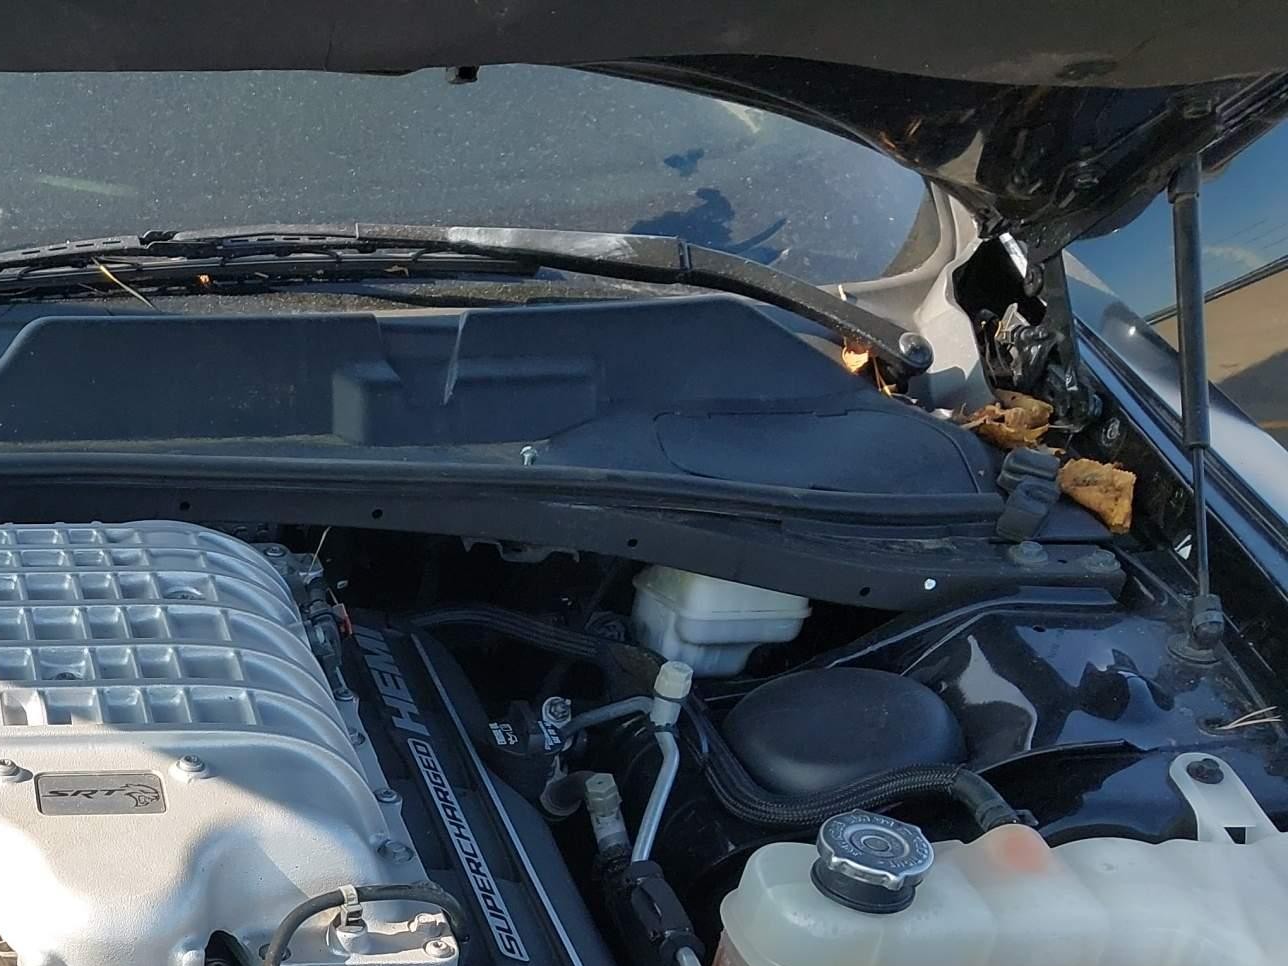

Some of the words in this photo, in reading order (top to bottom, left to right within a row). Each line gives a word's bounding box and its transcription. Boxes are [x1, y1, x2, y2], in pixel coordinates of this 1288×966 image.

[355, 628, 431, 736] HEMI
[42, 789, 125, 799] SRT
[413, 740, 524, 958] SUPERCHARGED
